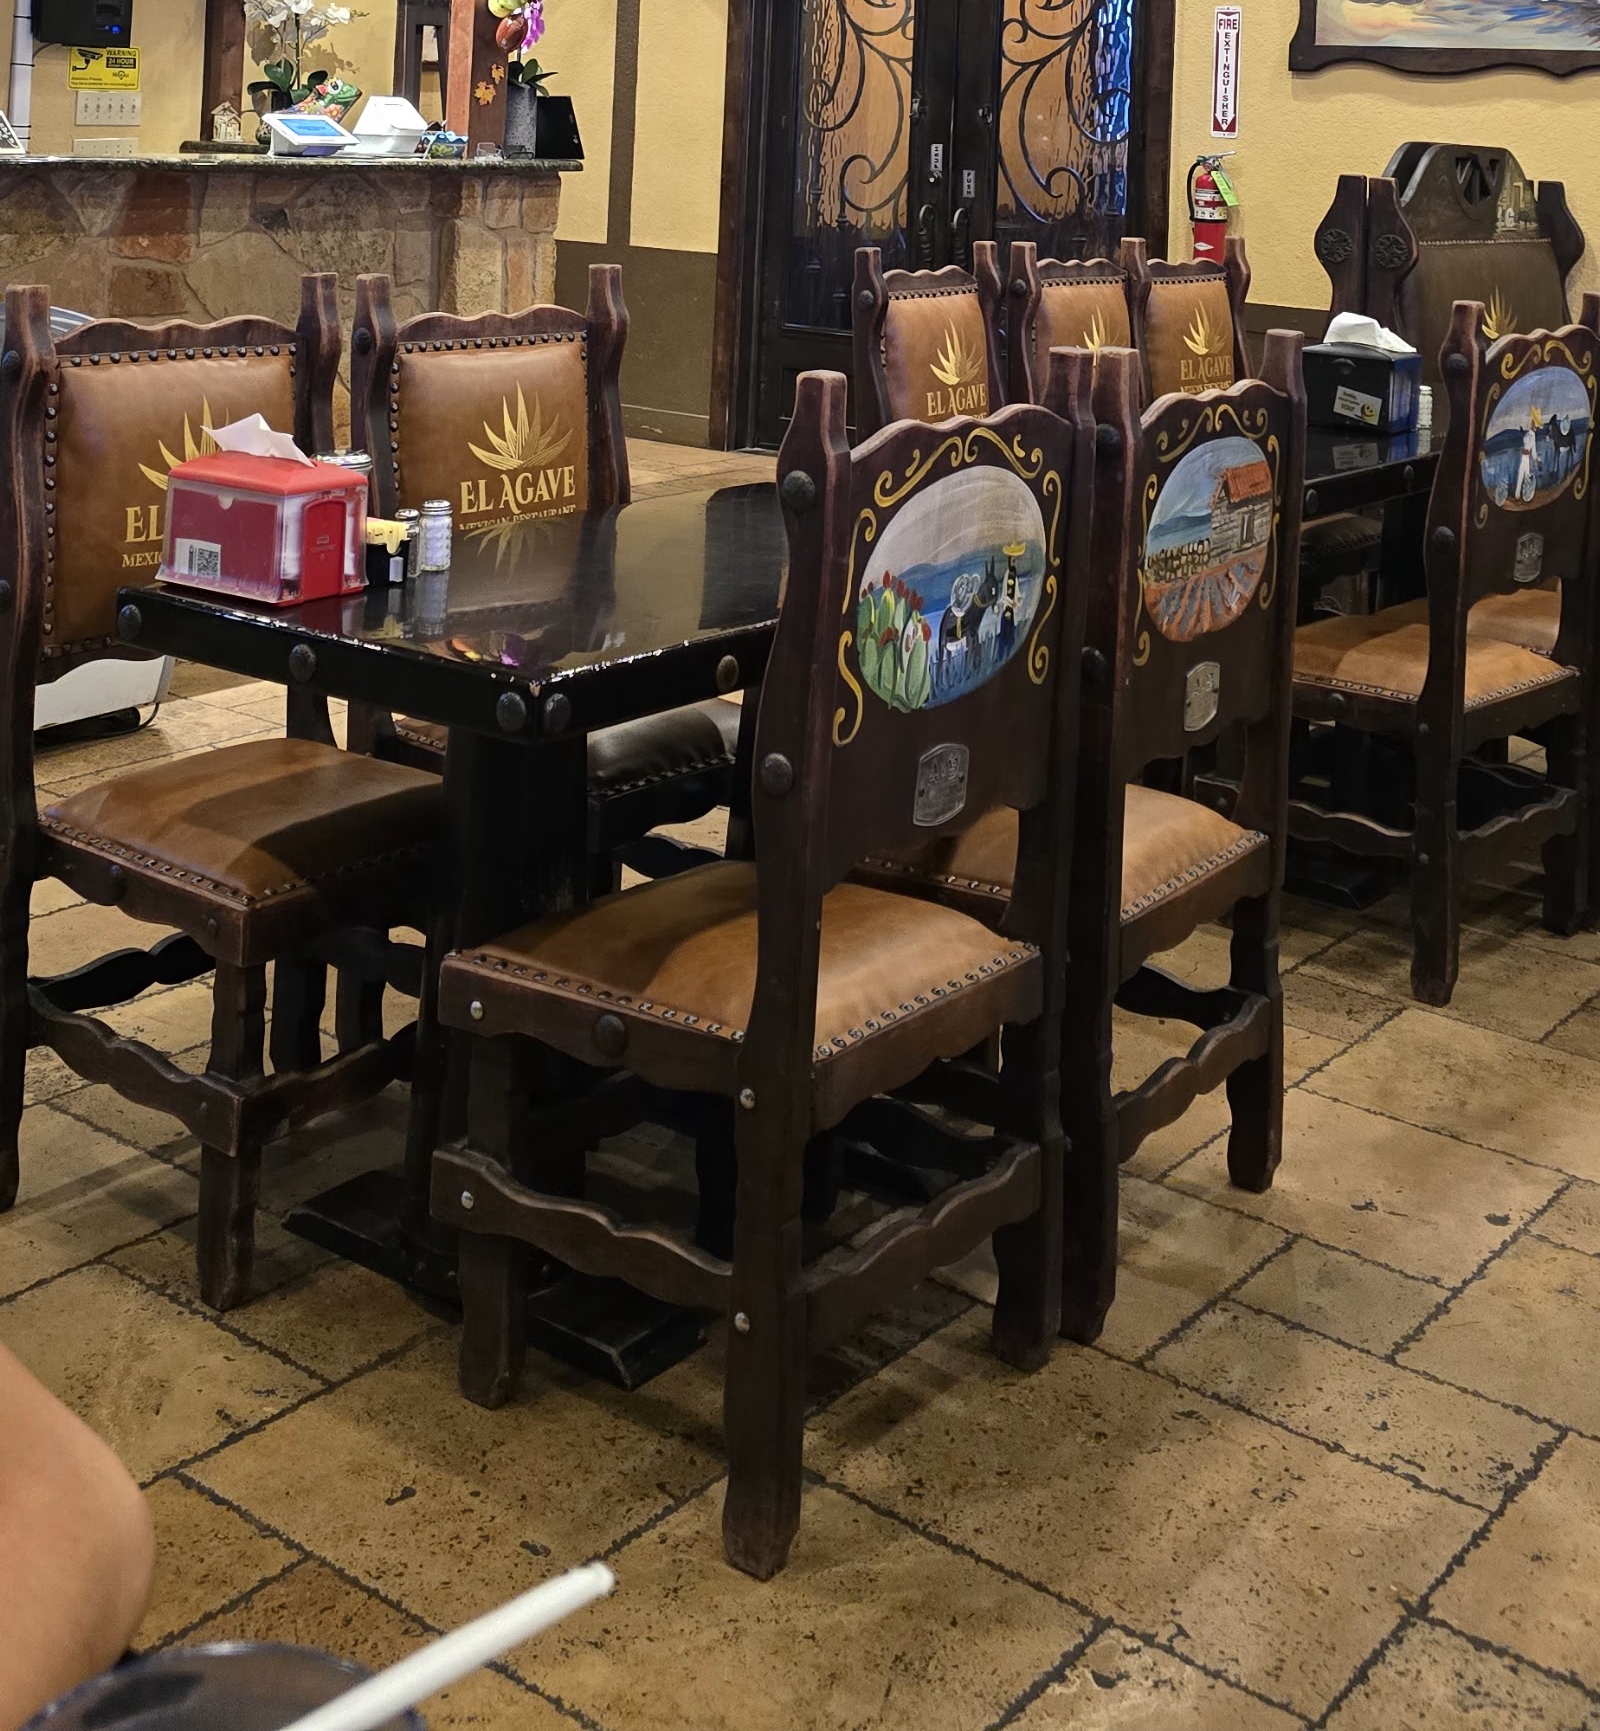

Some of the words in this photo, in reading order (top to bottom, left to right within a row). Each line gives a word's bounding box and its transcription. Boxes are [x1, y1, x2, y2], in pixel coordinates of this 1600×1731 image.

[1218, 18, 1238, 30] FIRE
[1221, 32, 1231, 126] EXTINGUISHER
[1180, 360, 1197, 380] EL
[1198, 355, 1232, 383] AGAVE
[926, 391, 946, 416] EL
[948, 383, 987, 416] AGAVE
[460, 480, 494, 514] EL
[498, 465, 576, 514] AGAVE
[124, 505, 164, 543] EL
